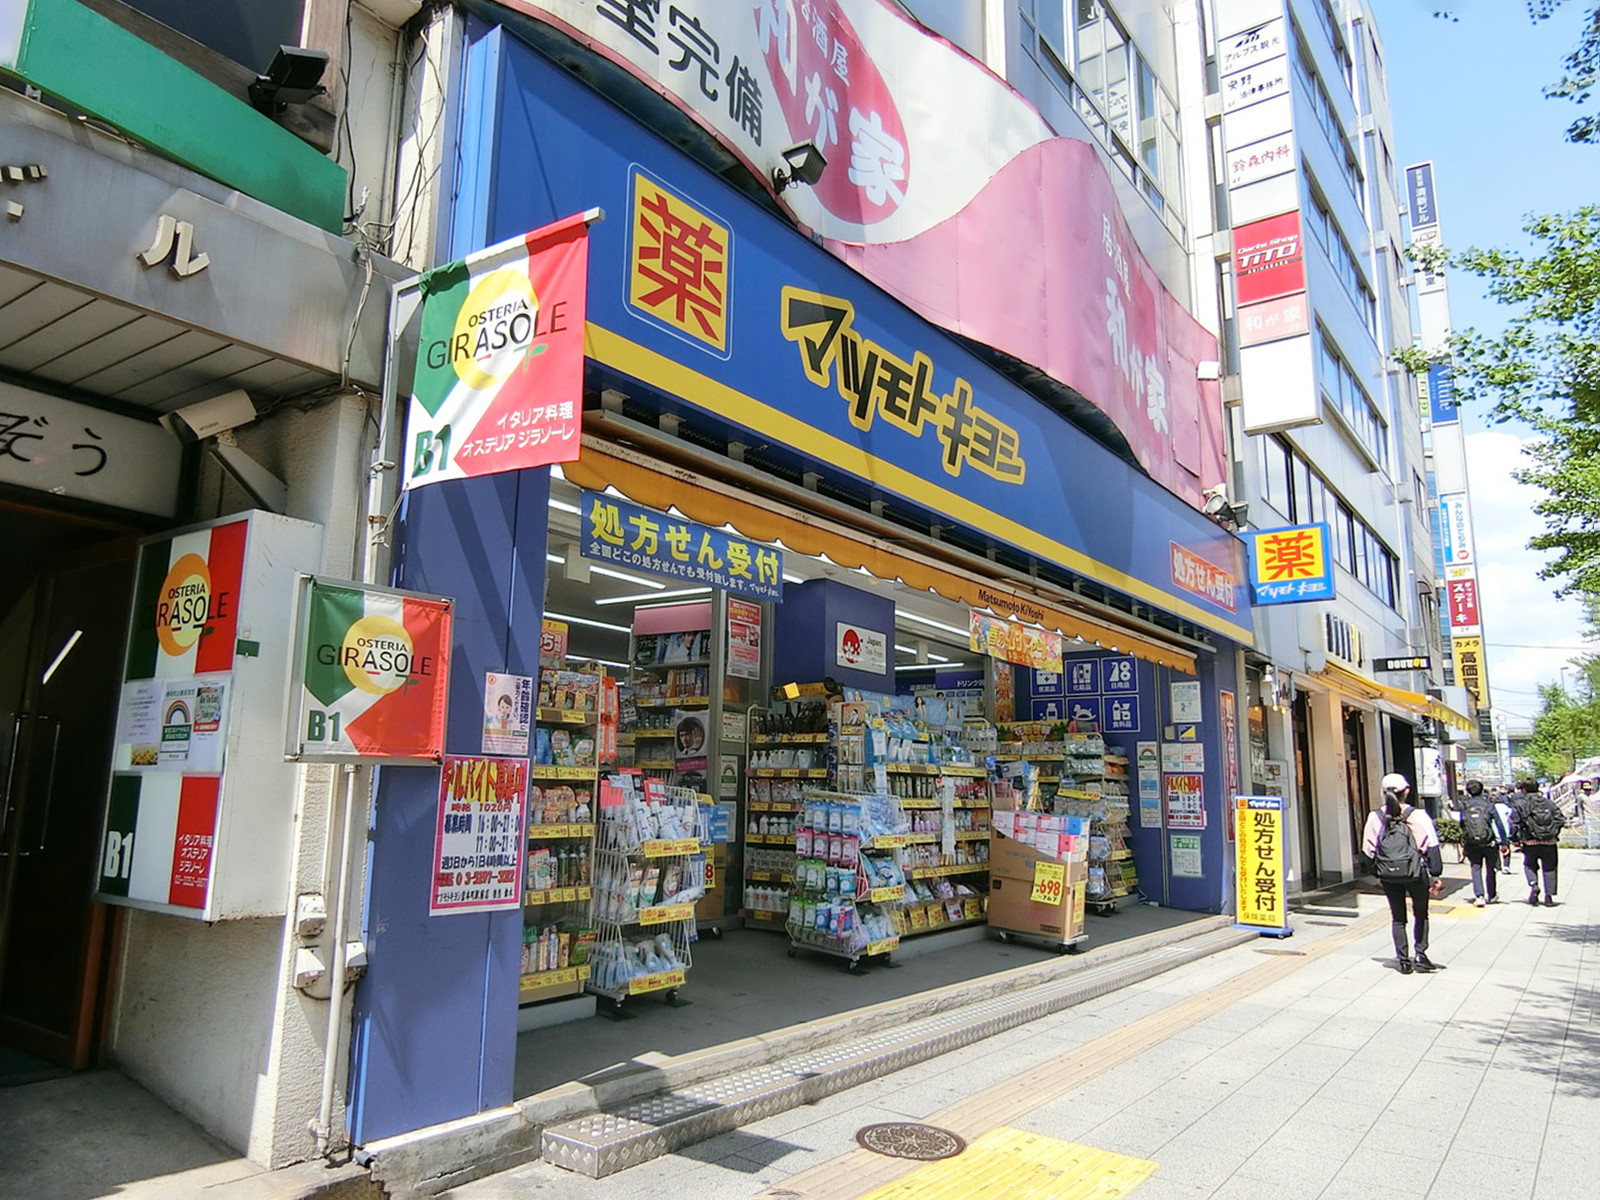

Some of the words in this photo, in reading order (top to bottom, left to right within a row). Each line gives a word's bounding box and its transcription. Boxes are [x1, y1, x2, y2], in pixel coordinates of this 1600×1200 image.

[1224, 36, 1280, 63] アルプス観光
[1269, 234, 1298, 246] Shop
[638, 192, 723, 342] 薬
[468, 299, 528, 328] OSTERIA
[427, 301, 568, 369] GIRASOLE
[1106, 277, 1168, 435] 和が家
[783, 288, 1025, 482] マツモトキヨシ
[497, 401, 574, 430] イタリア料理
[412, 424, 451, 478] B1
[462, 431, 516, 458] オステリア
[519, 424, 575, 449] ジラソーレ
[589, 499, 779, 586] 処方せん受付
[1264, 531, 1315, 580] 薬
[168, 583, 206, 599] OSTERIA
[1173, 548, 1234, 608] 処方せん受付
[1256, 581, 1327, 598] マツモトキヨシ
[148, 592, 229, 629] RASOLE
[978, 589, 1020, 614] Matsumoto
[1452, 583, 1467, 624] ステーキ
[316, 644, 432, 676] GIRASOLE
[357, 637, 408, 652] OSTERIA
[1454, 640, 1480, 648] カメラ
[307, 710, 340, 742] B1
[479, 803, 511, 812] 1020円
[103, 831, 134, 878] B1
[178, 834, 213, 848] イタリア料理
[181, 848, 208, 860] オステリア
[1253, 812, 1276, 912] 処方せん受付
[1040, 879, 1061, 896] 698
